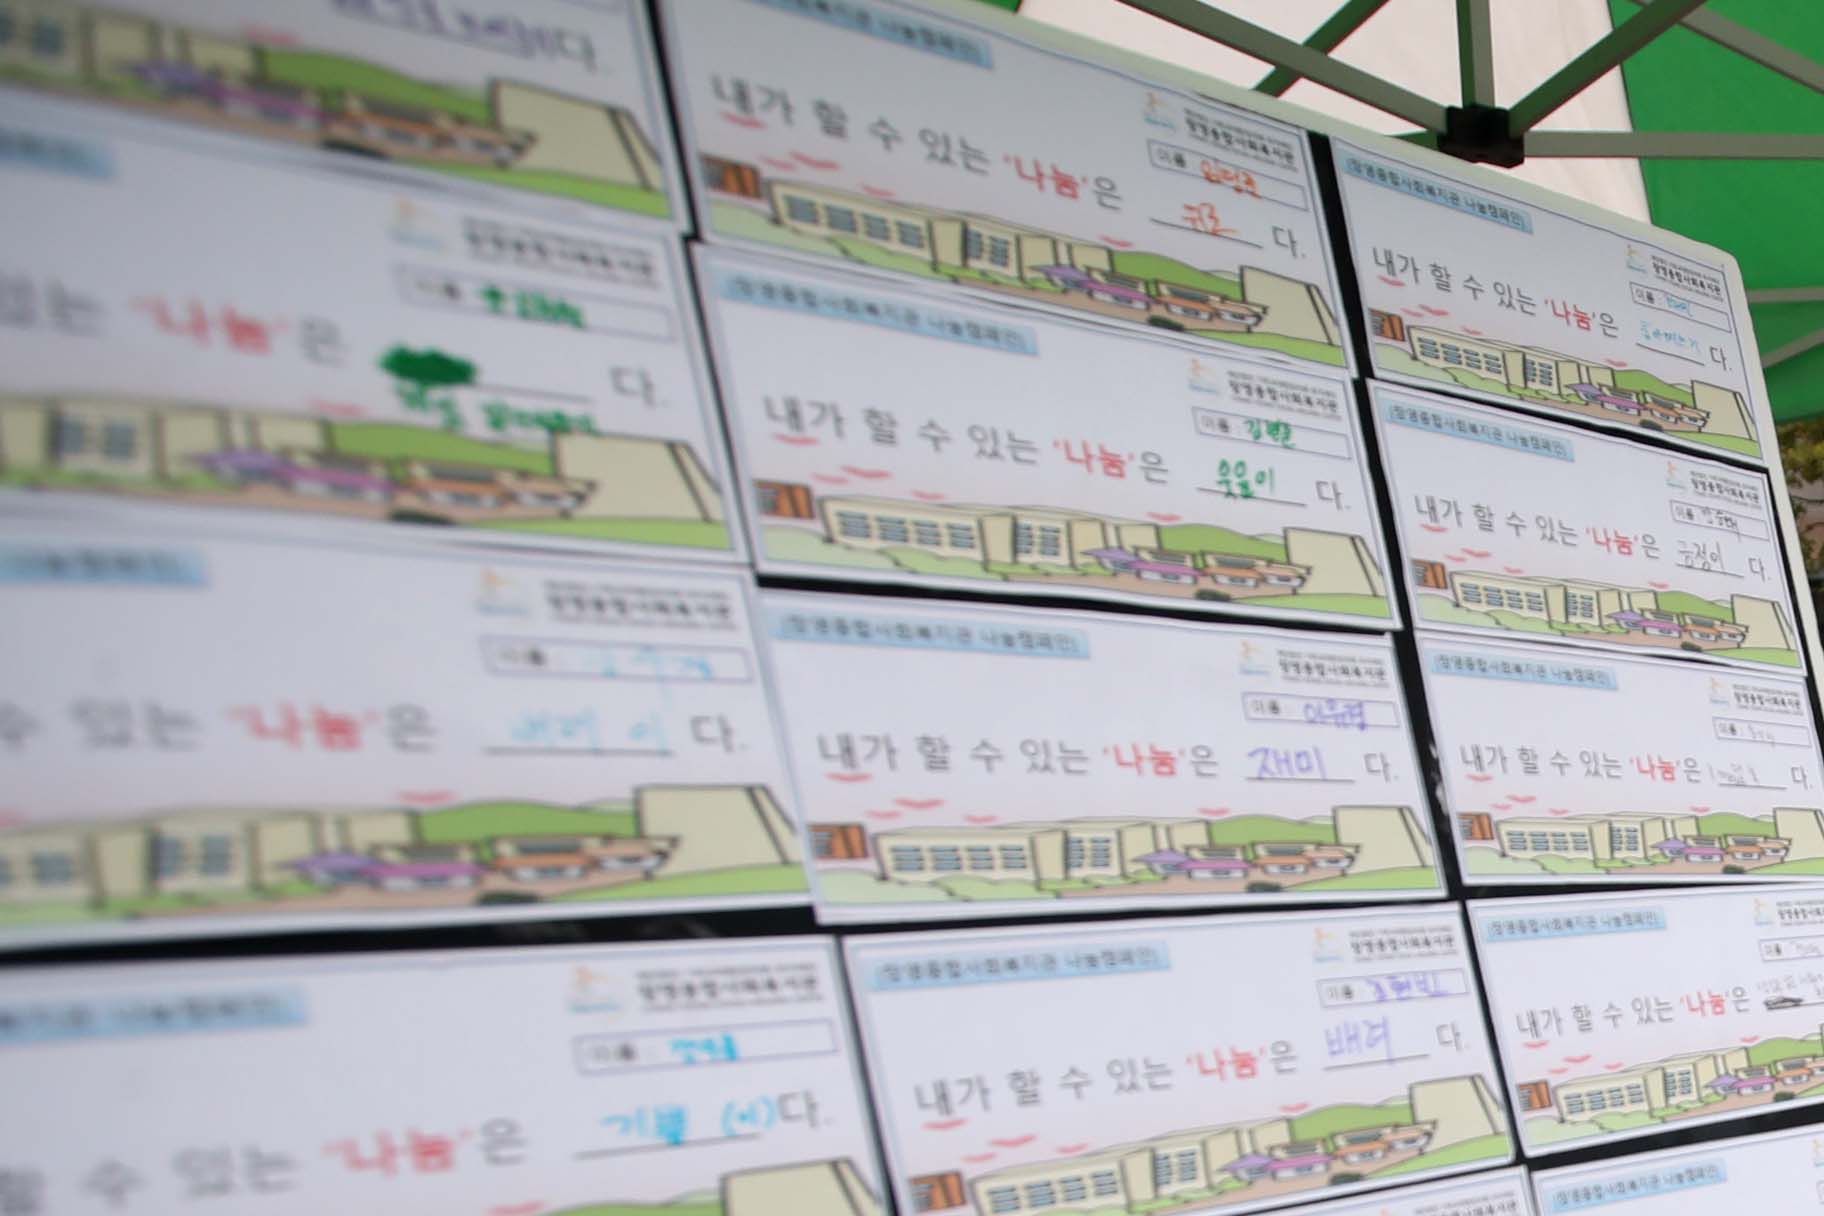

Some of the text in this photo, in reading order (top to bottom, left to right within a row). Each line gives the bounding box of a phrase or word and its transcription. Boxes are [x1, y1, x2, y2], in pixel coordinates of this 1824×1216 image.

[1372, 247, 1420, 284] 내가
[1429, 263, 1451, 293] 할
[1463, 275, 1484, 301] 수
[1493, 281, 1536, 316] 있는
[1414, 495, 1462, 527] 내가
[1472, 504, 1494, 533] 할
[1506, 511, 1527, 537] 수
[1535, 515, 1578, 547] 있는
[1247, 746, 1328, 780] 재미
[1460, 744, 1507, 774] 내가
[1517, 747, 1539, 775] 할
[1550, 751, 1571, 776] 수
[1579, 750, 1622, 779] 있는
